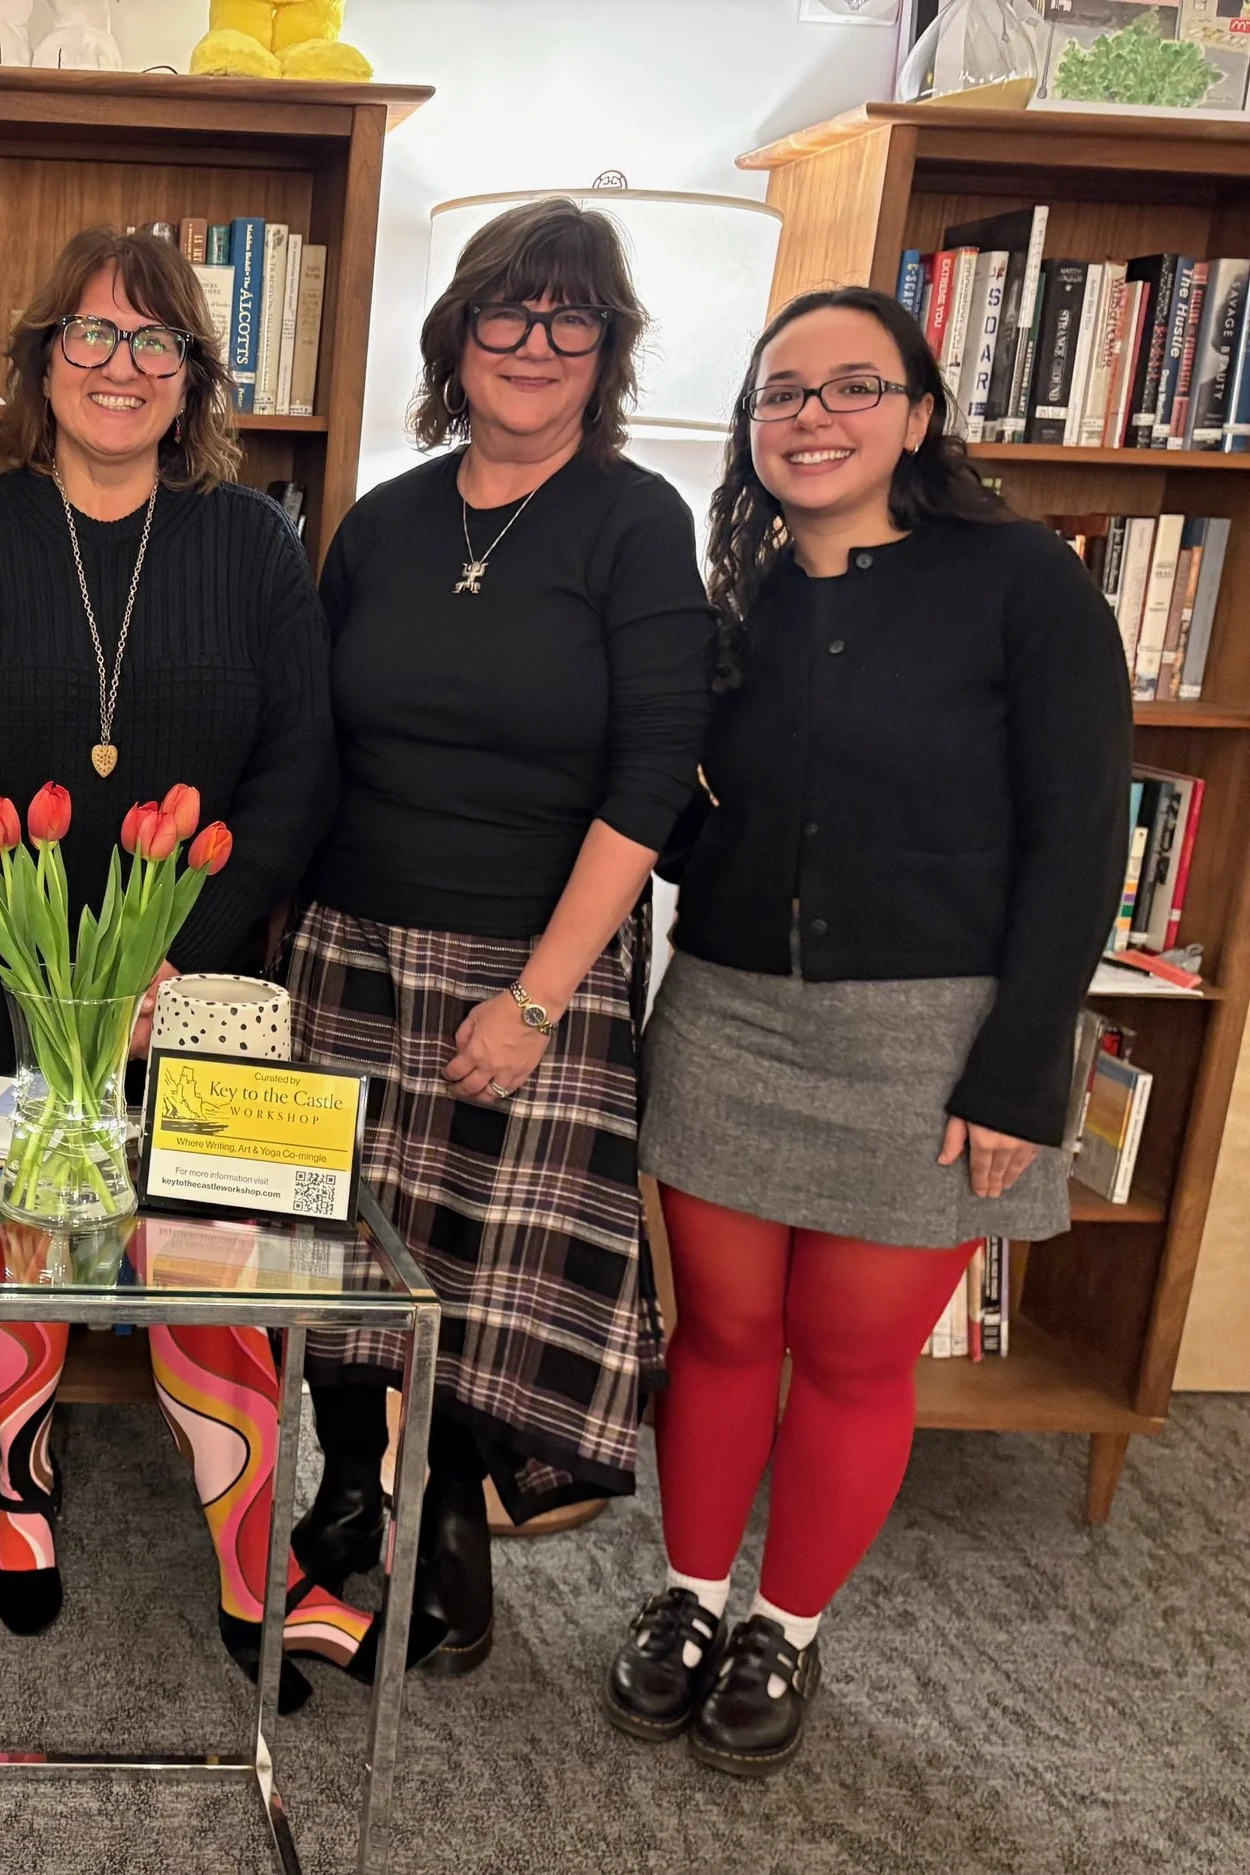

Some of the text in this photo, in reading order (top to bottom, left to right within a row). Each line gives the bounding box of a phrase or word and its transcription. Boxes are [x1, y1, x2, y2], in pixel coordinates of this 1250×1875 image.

[934, 259, 951, 328] EXTREME YOU
[1170, 268, 1194, 359] The Hustle
[1223, 282, 1241, 337] SAVAGE
[236, 288, 253, 365] ALCOTTS
[976, 288, 1001, 390] SOAR
[1054, 309, 1071, 358] STRANGE
[1158, 369, 1170, 392] Doug
[255, 1072, 300, 1086] Curated by
[210, 1081, 343, 1110] Key to the Castle
[230, 1106, 320, 1125] WORKSHOP
[177, 1137, 327, 1163] Where Writing, Art & Yoga Co-mingle
[162, 1177, 281, 1199] keytothecastleworkshop.com
[175, 1167, 269, 1185] For more information visit
